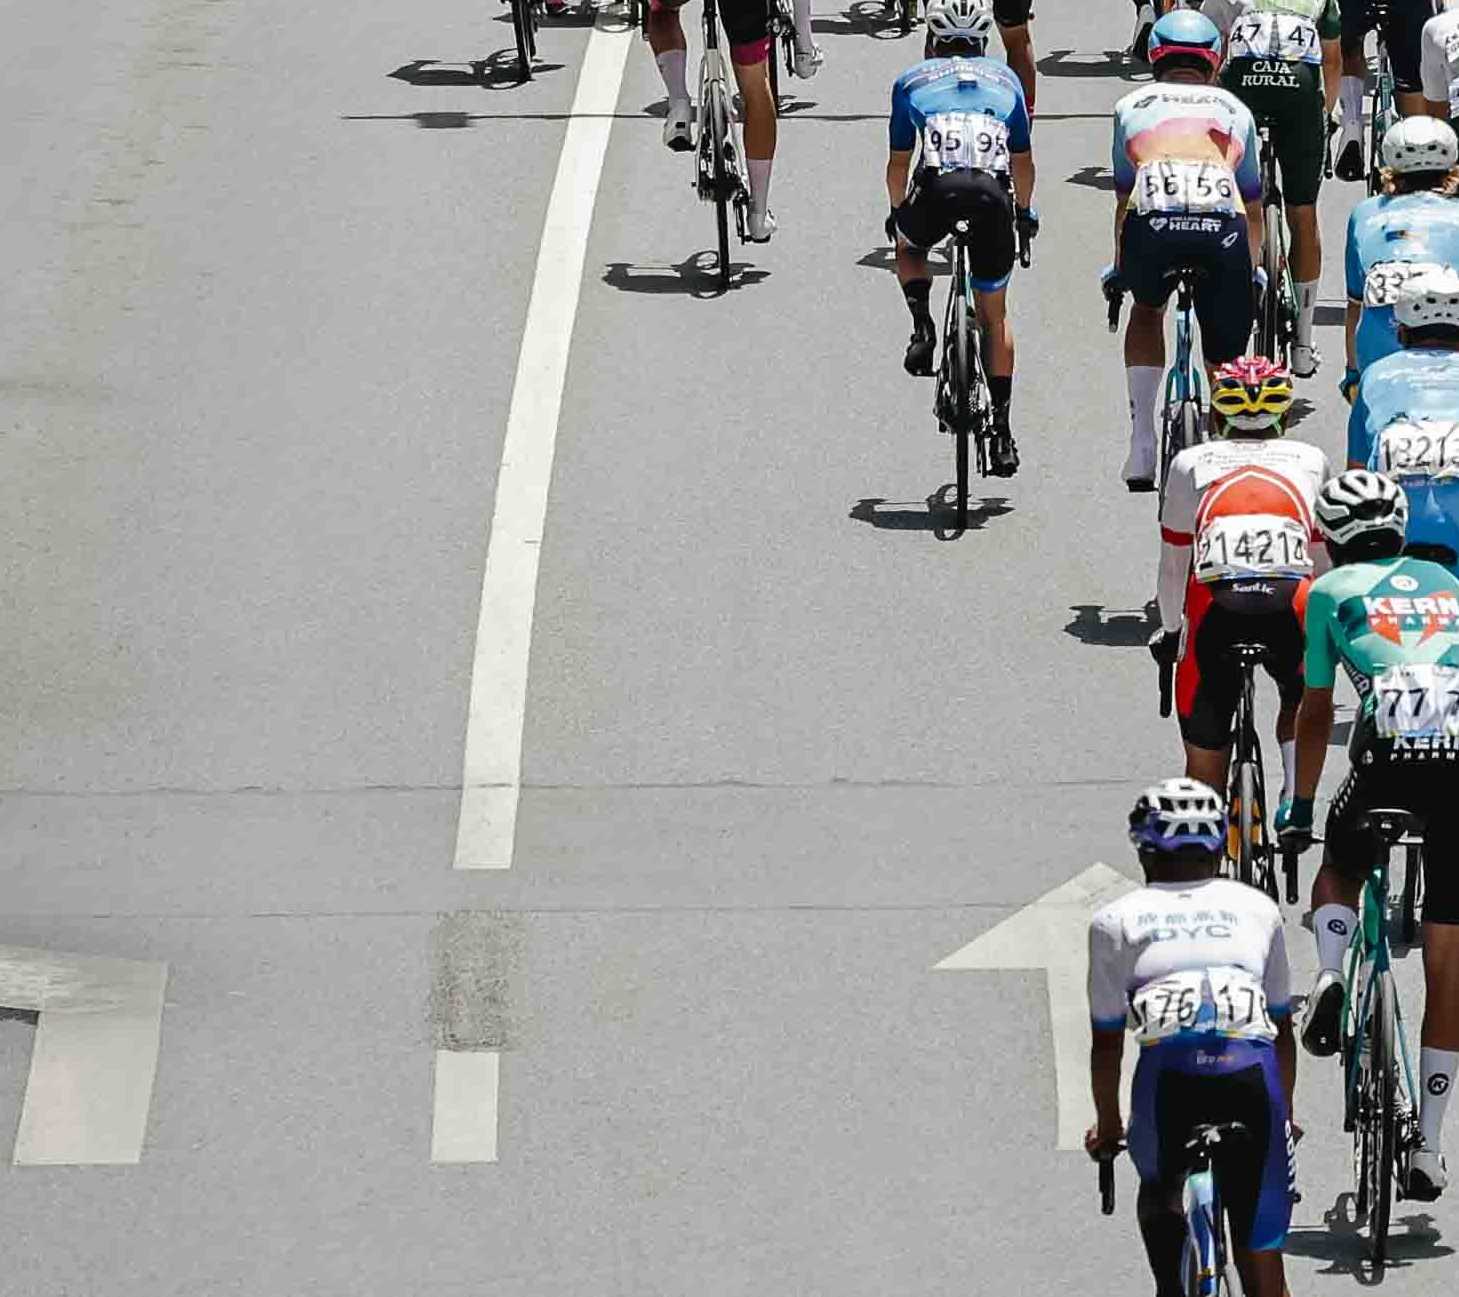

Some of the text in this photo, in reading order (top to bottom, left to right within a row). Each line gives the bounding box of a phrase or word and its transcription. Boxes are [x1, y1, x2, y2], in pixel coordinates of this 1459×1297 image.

[1231, 24, 1315, 46] 47 47
[1252, 61, 1291, 74] CAJA
[1241, 74, 1299, 87] RURAL
[930, 130, 960, 153] 95
[1197, 172, 1231, 197] 56
[1169, 221, 1221, 232] HEART
[1364, 597, 1459, 616] KERN
[1382, 688, 1423, 716] 77
